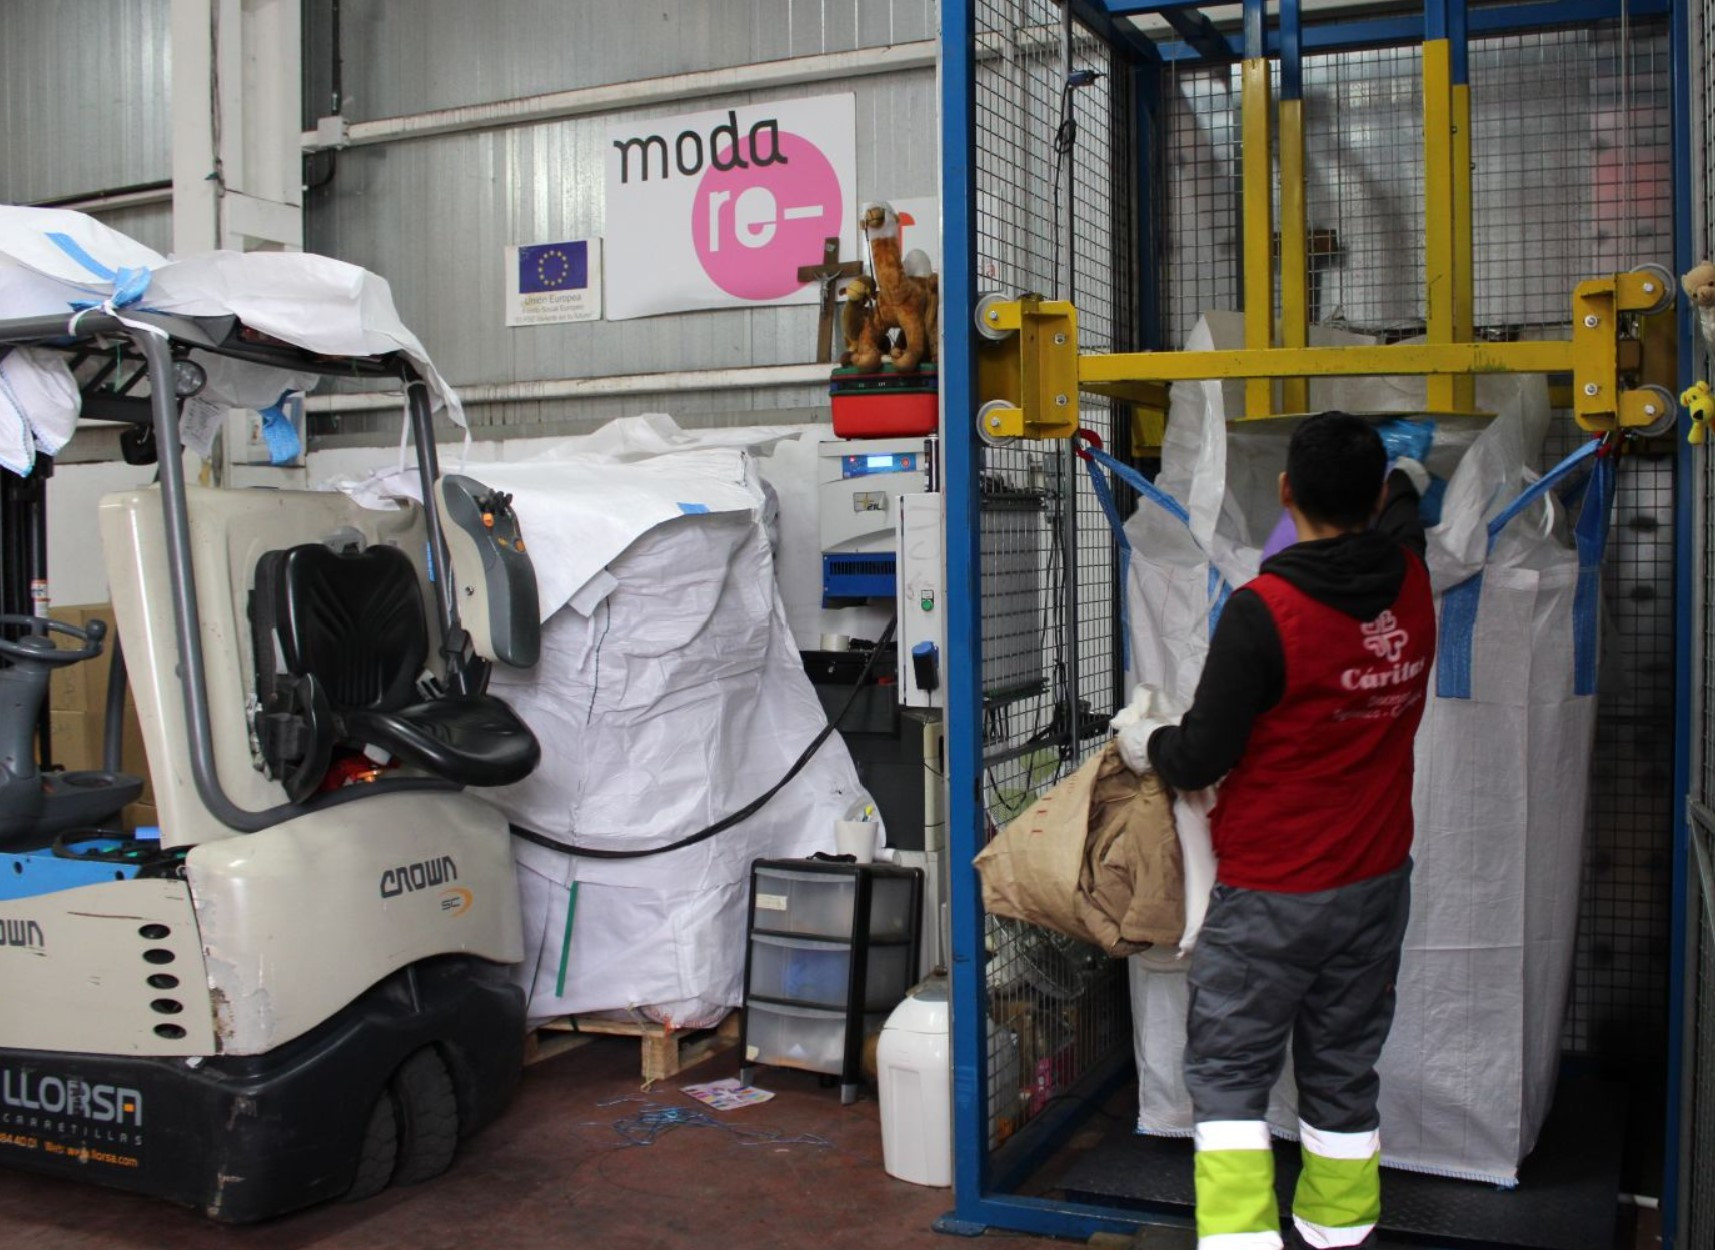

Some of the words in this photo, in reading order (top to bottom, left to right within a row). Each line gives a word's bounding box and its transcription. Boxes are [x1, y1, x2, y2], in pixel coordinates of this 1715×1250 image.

[613, 110, 788, 184] moda
[3, 1069, 143, 1127] LLORSA
[2, 1112, 143, 1146] CARRETILLAS
